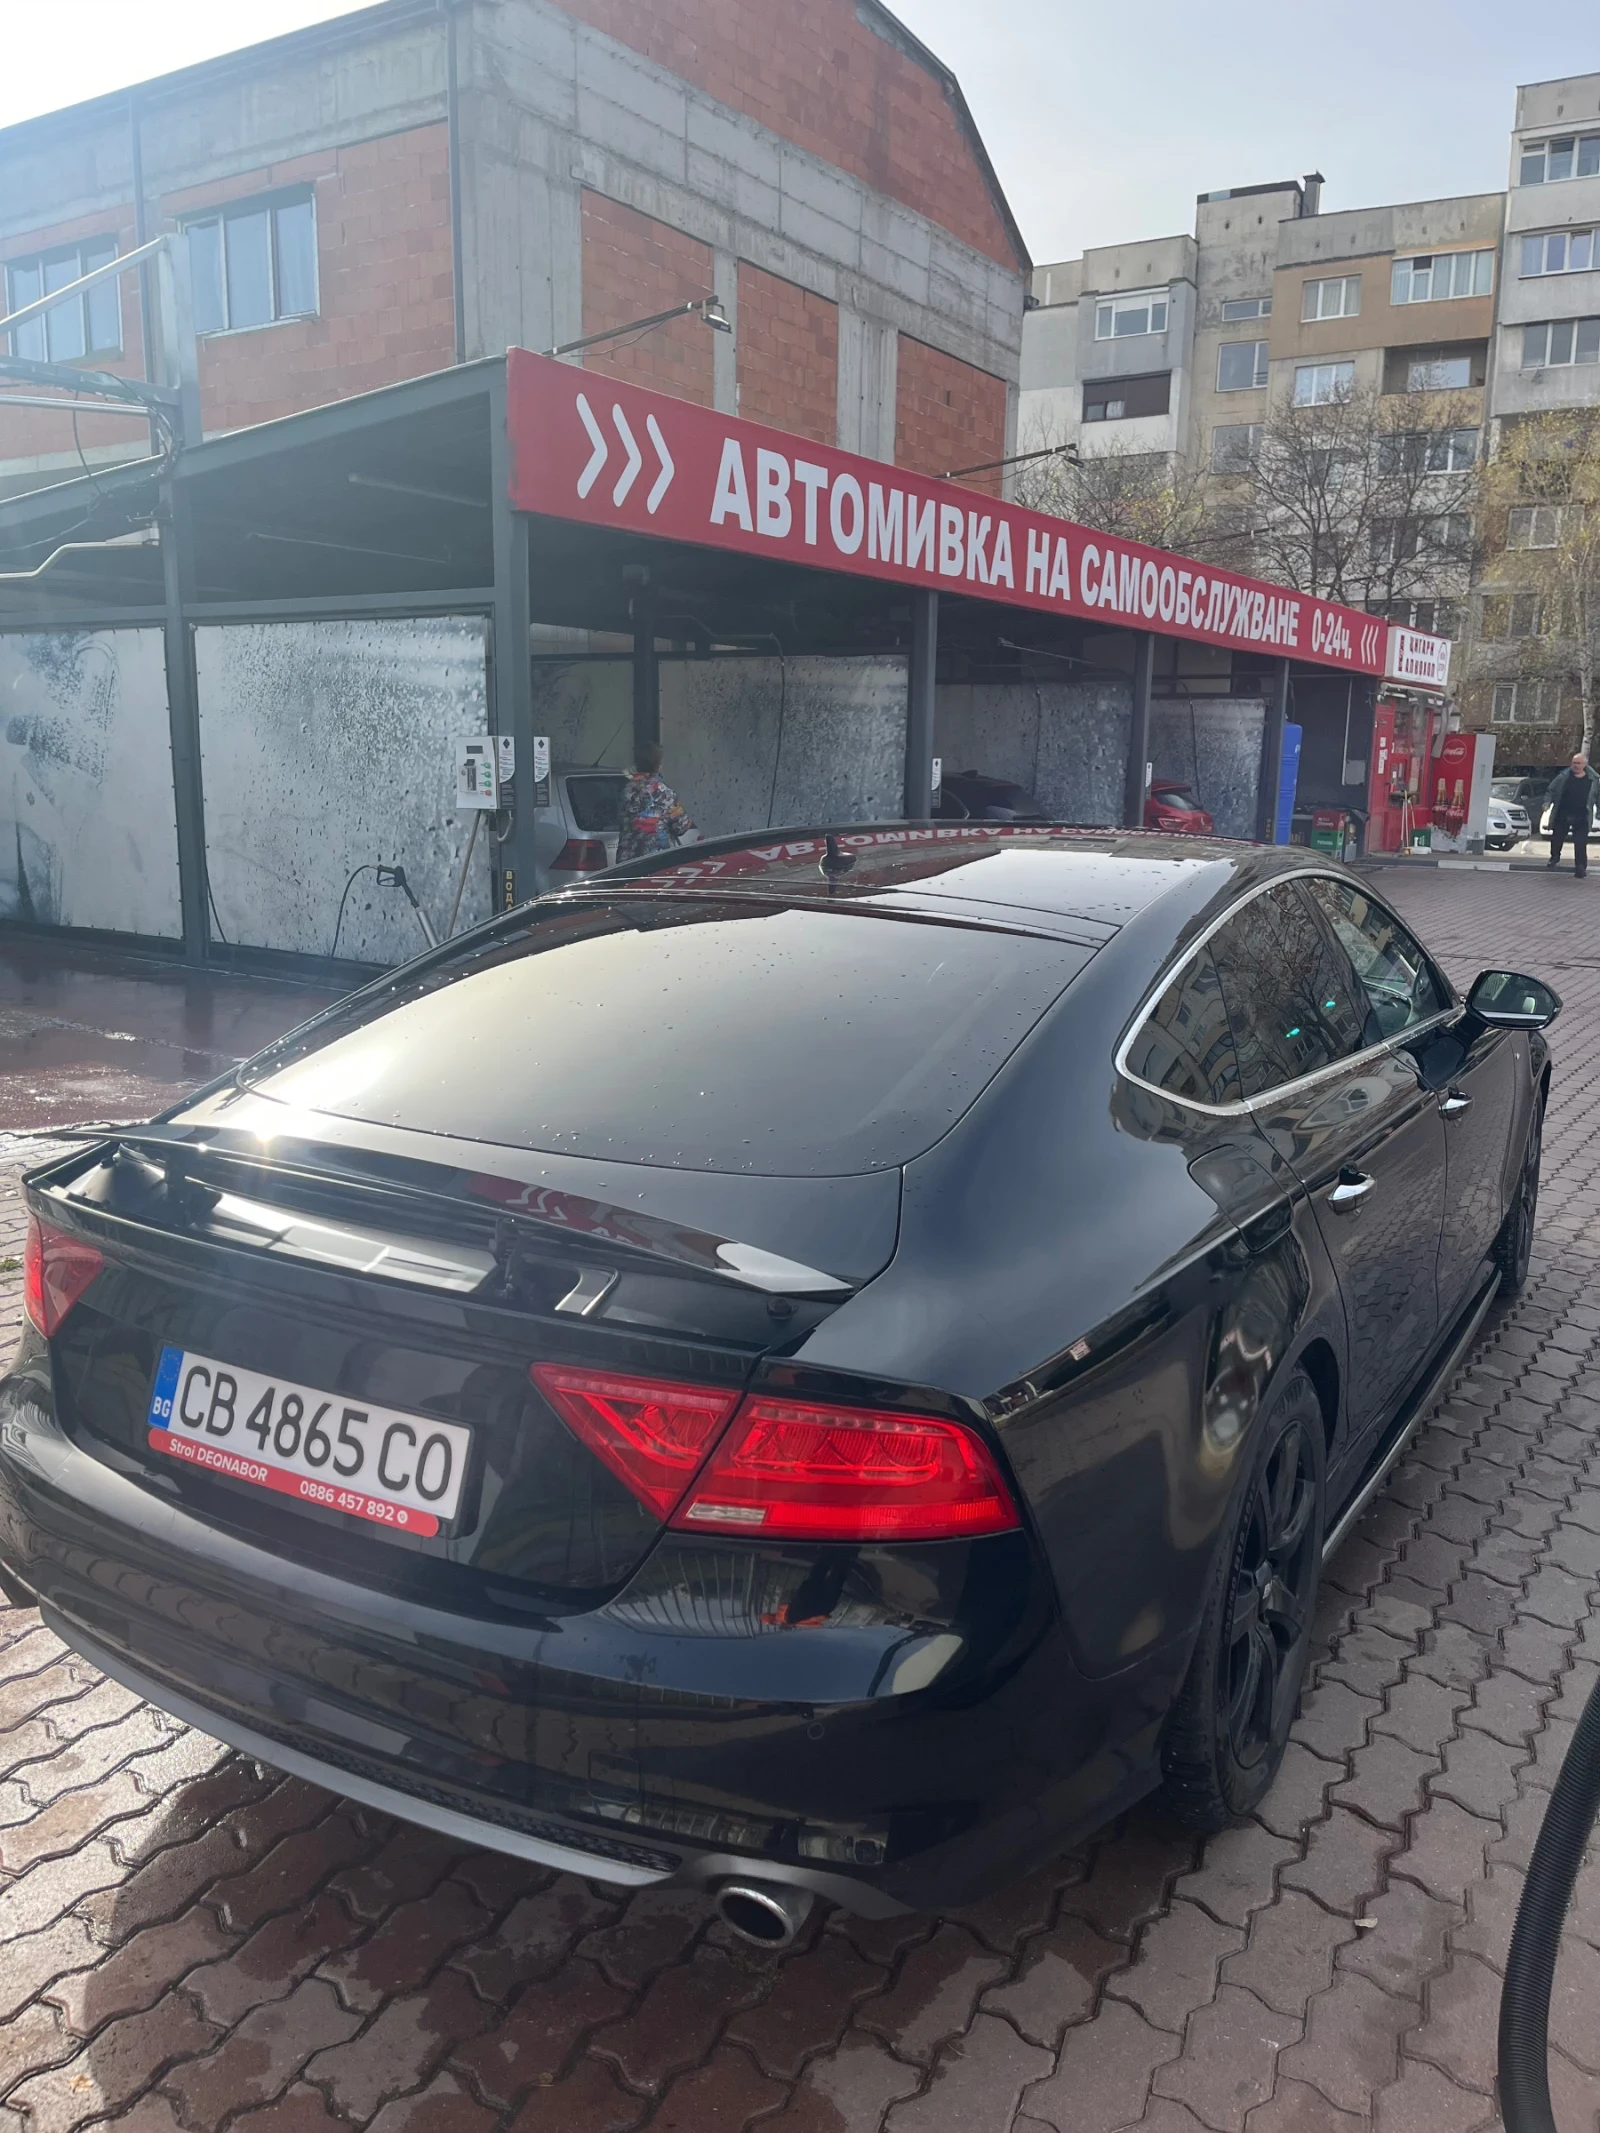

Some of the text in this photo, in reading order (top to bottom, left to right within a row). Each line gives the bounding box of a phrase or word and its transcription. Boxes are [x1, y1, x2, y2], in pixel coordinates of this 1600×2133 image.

[709, 436, 1015, 589] АВТОМИВКА
[1025, 528, 1071, 601] НА
[1080, 543, 1300, 647] САМООБСЛУЖВАНЕ
[152, 1396, 171, 1418] BG
[179, 1365, 238, 1437] CB
[245, 1386, 369, 1477] 4865
[169, 1438, 395, 1521] Stroi DEQNABOR 0886 457 892
